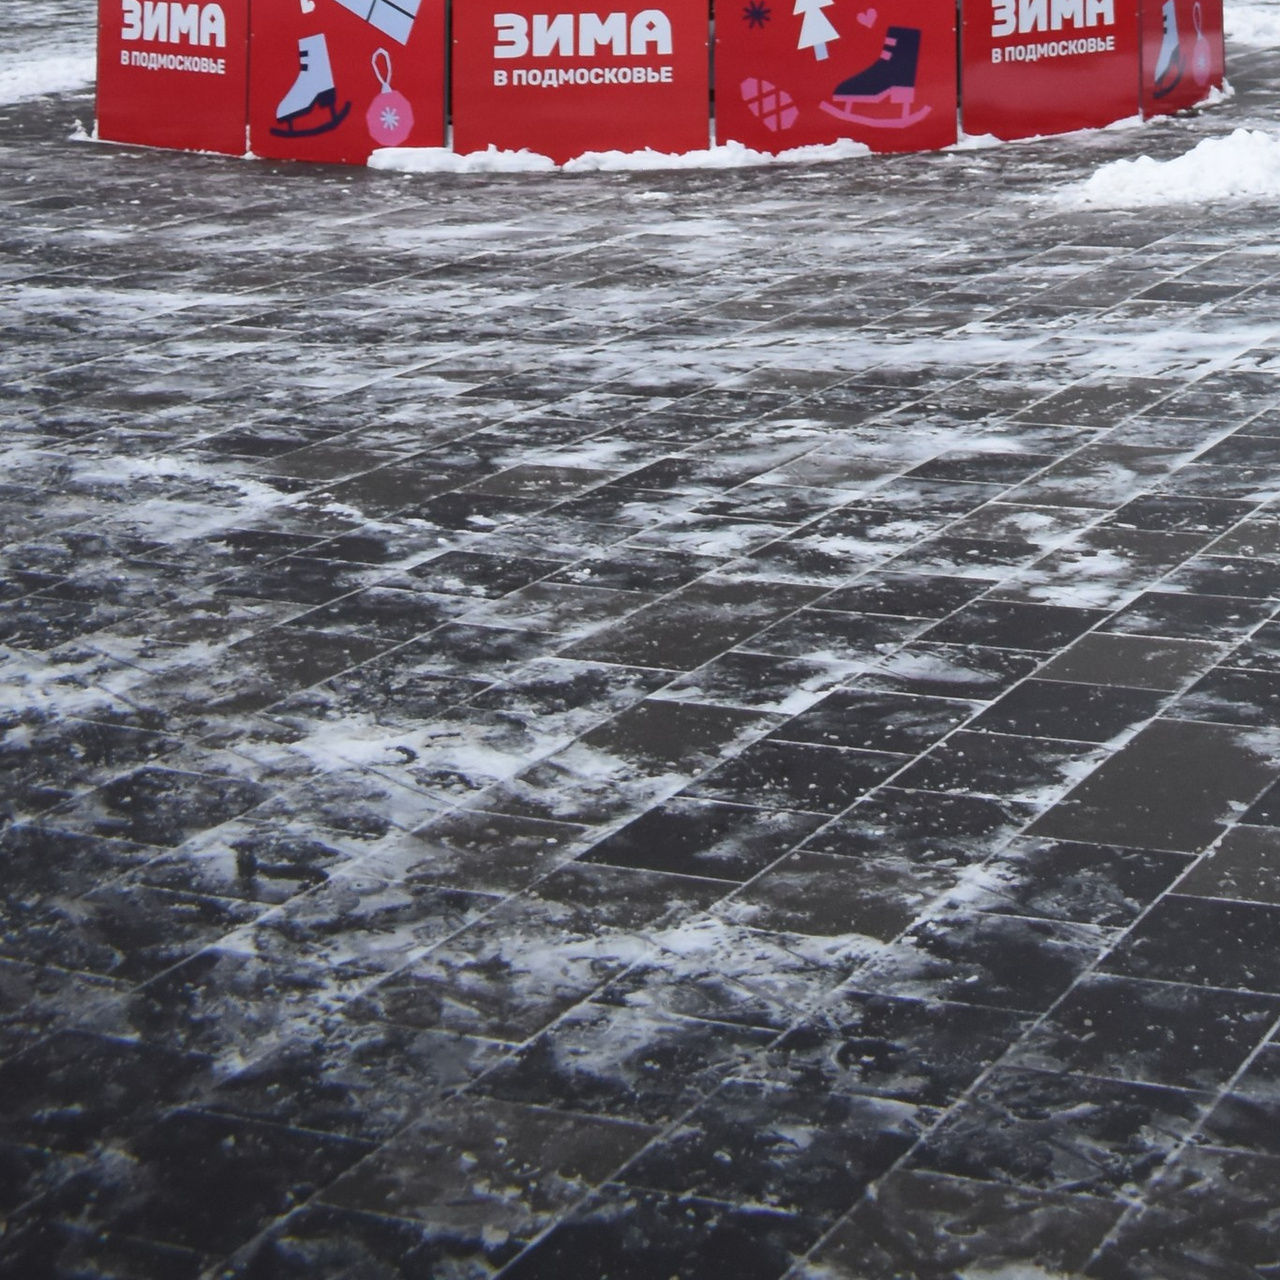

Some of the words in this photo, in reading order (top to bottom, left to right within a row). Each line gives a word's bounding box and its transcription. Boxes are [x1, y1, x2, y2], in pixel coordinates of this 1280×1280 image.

[494, 9, 673, 58] ЗИМА
[120, 50, 130, 65] В
[131, 51, 226, 74] ПОДМОСКОВЬЕ
[991, 48, 1002, 64] В
[1004, 36, 1115, 62] ПОДМОСКОВЬЕ
[493, 70, 508, 86] В
[512, 66, 673, 87] ПОДМОСКОВЬЕ
